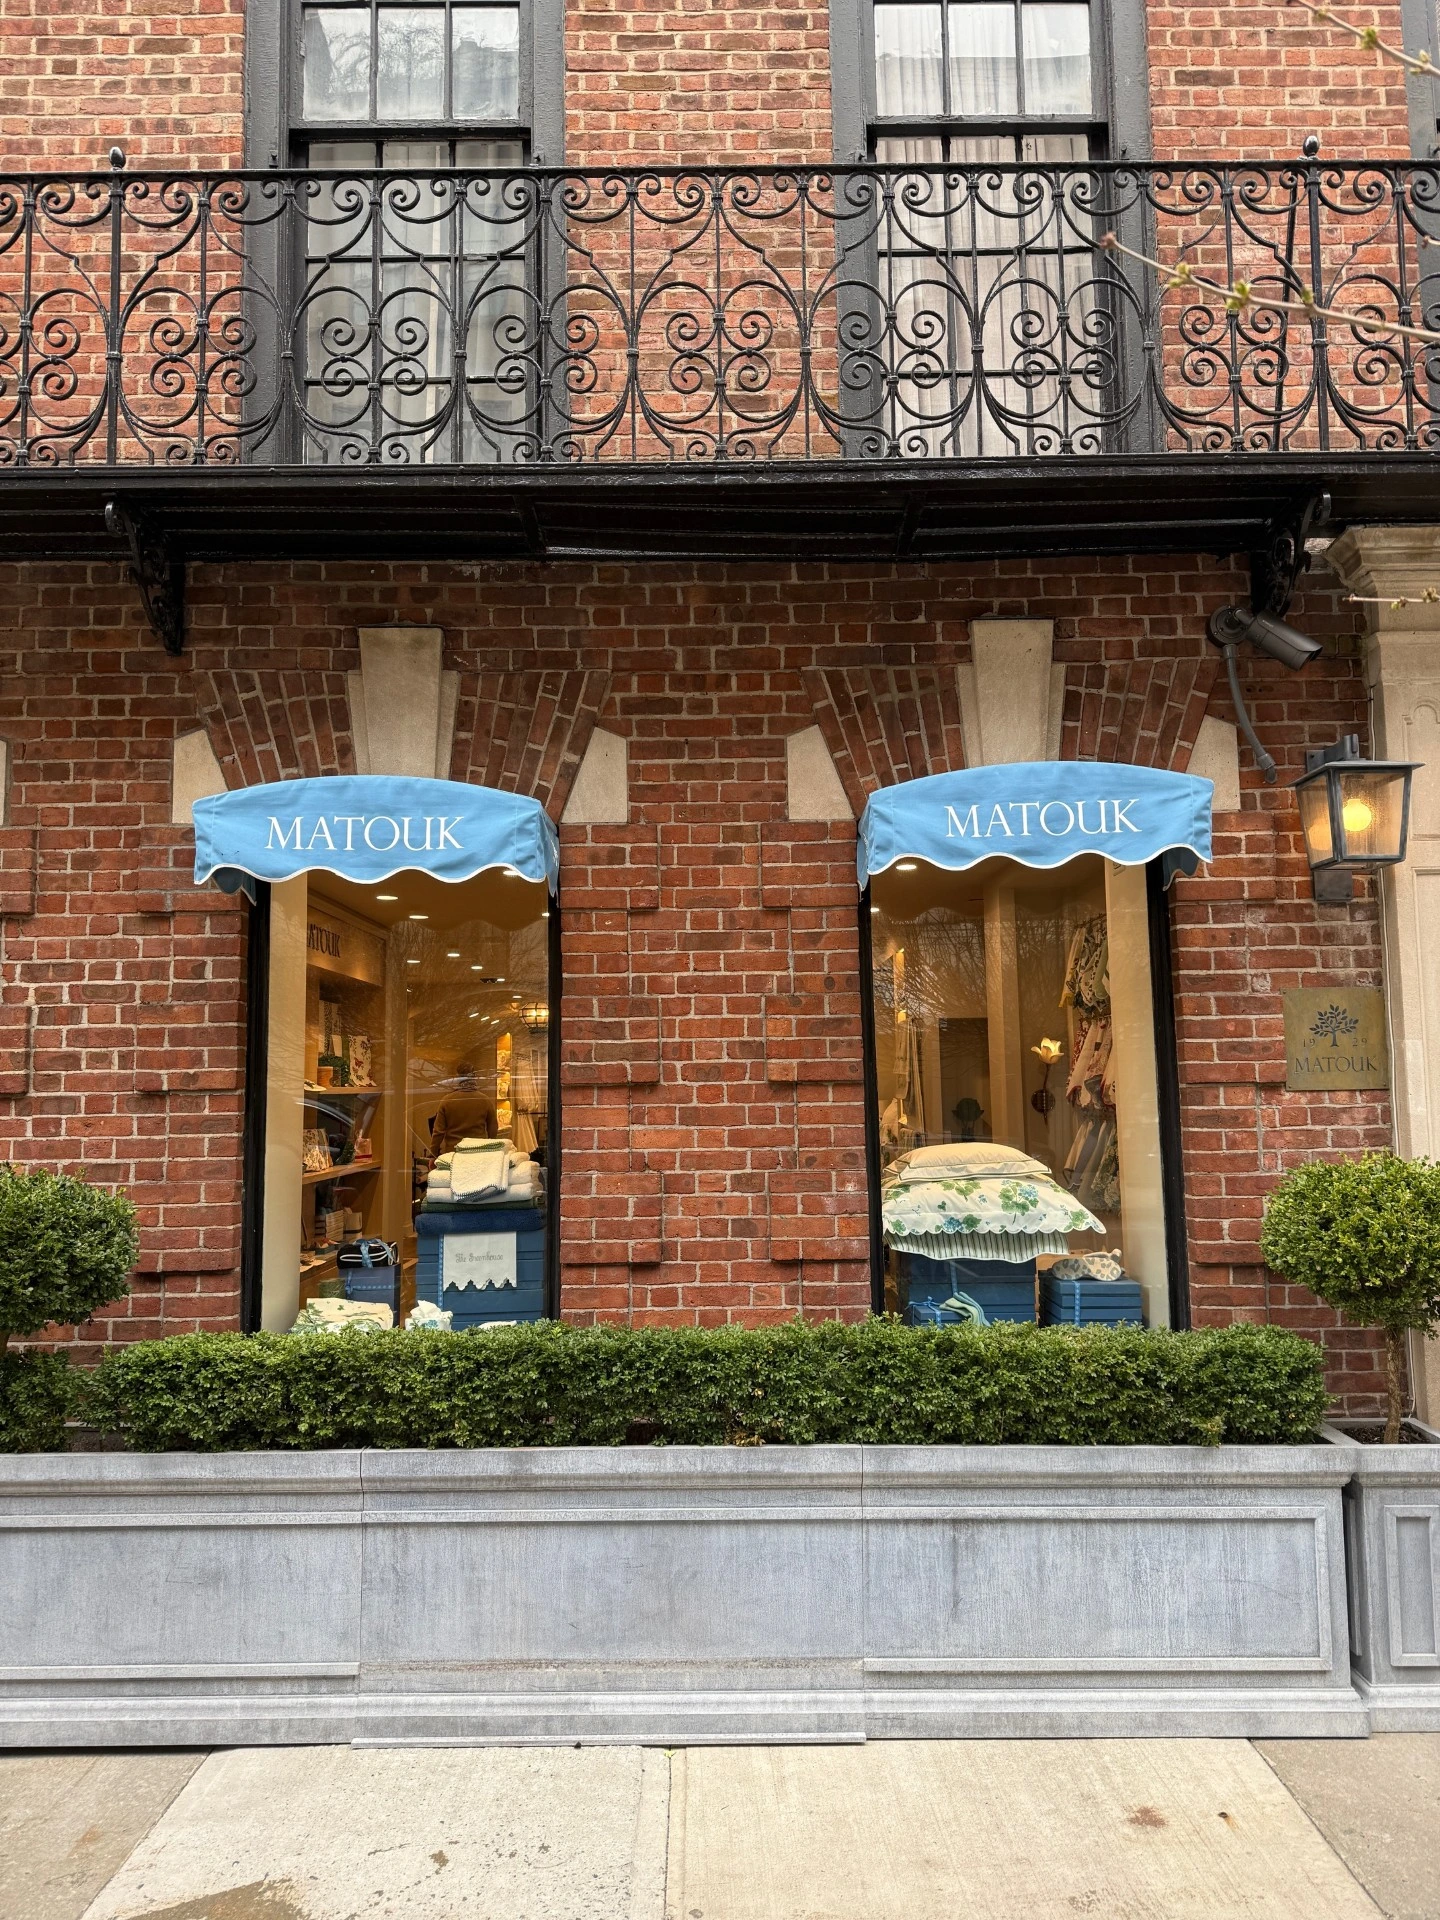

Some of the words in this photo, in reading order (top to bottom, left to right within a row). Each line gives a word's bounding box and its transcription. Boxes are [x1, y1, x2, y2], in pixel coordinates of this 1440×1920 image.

[264, 815, 465, 851] MATOUK
[943, 798, 1142, 838] MATOUK
[307, 923, 341, 959] ATOUK
[1295, 1056, 1378, 1074] MATOUK
